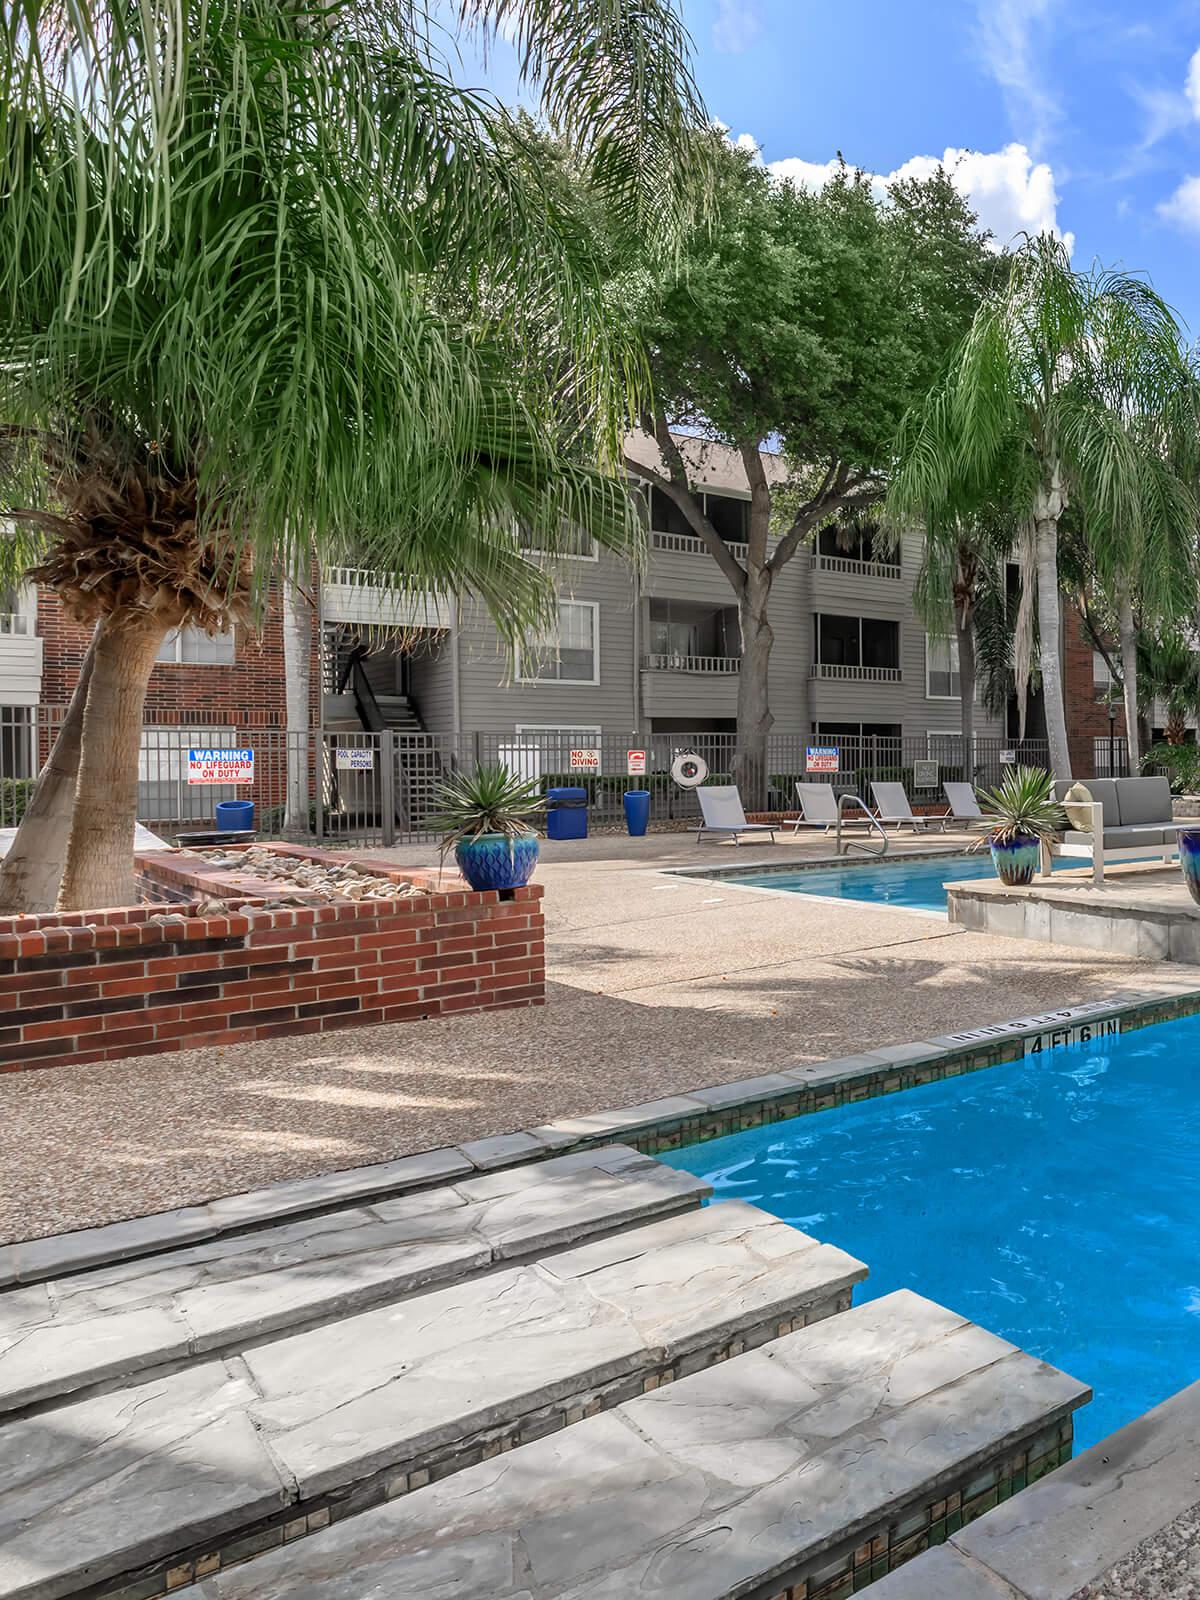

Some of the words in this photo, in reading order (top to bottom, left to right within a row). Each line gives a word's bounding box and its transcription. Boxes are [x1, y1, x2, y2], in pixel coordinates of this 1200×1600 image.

[194, 751, 249, 761] WARNING
[338, 750, 349, 758] POOL
[190, 761, 202, 769] NO
[206, 761, 252, 769] LIFEGUARD
[571, 758, 599, 766] DIVING
[202, 770, 214, 778] ON
[1031, 1016, 1056, 1024] FT
[1031, 1036, 1043, 1054] 4
[1052, 1029, 1072, 1049] FT
[1080, 1026, 1091, 1043] 6
[1100, 1020, 1117, 1038] IN
